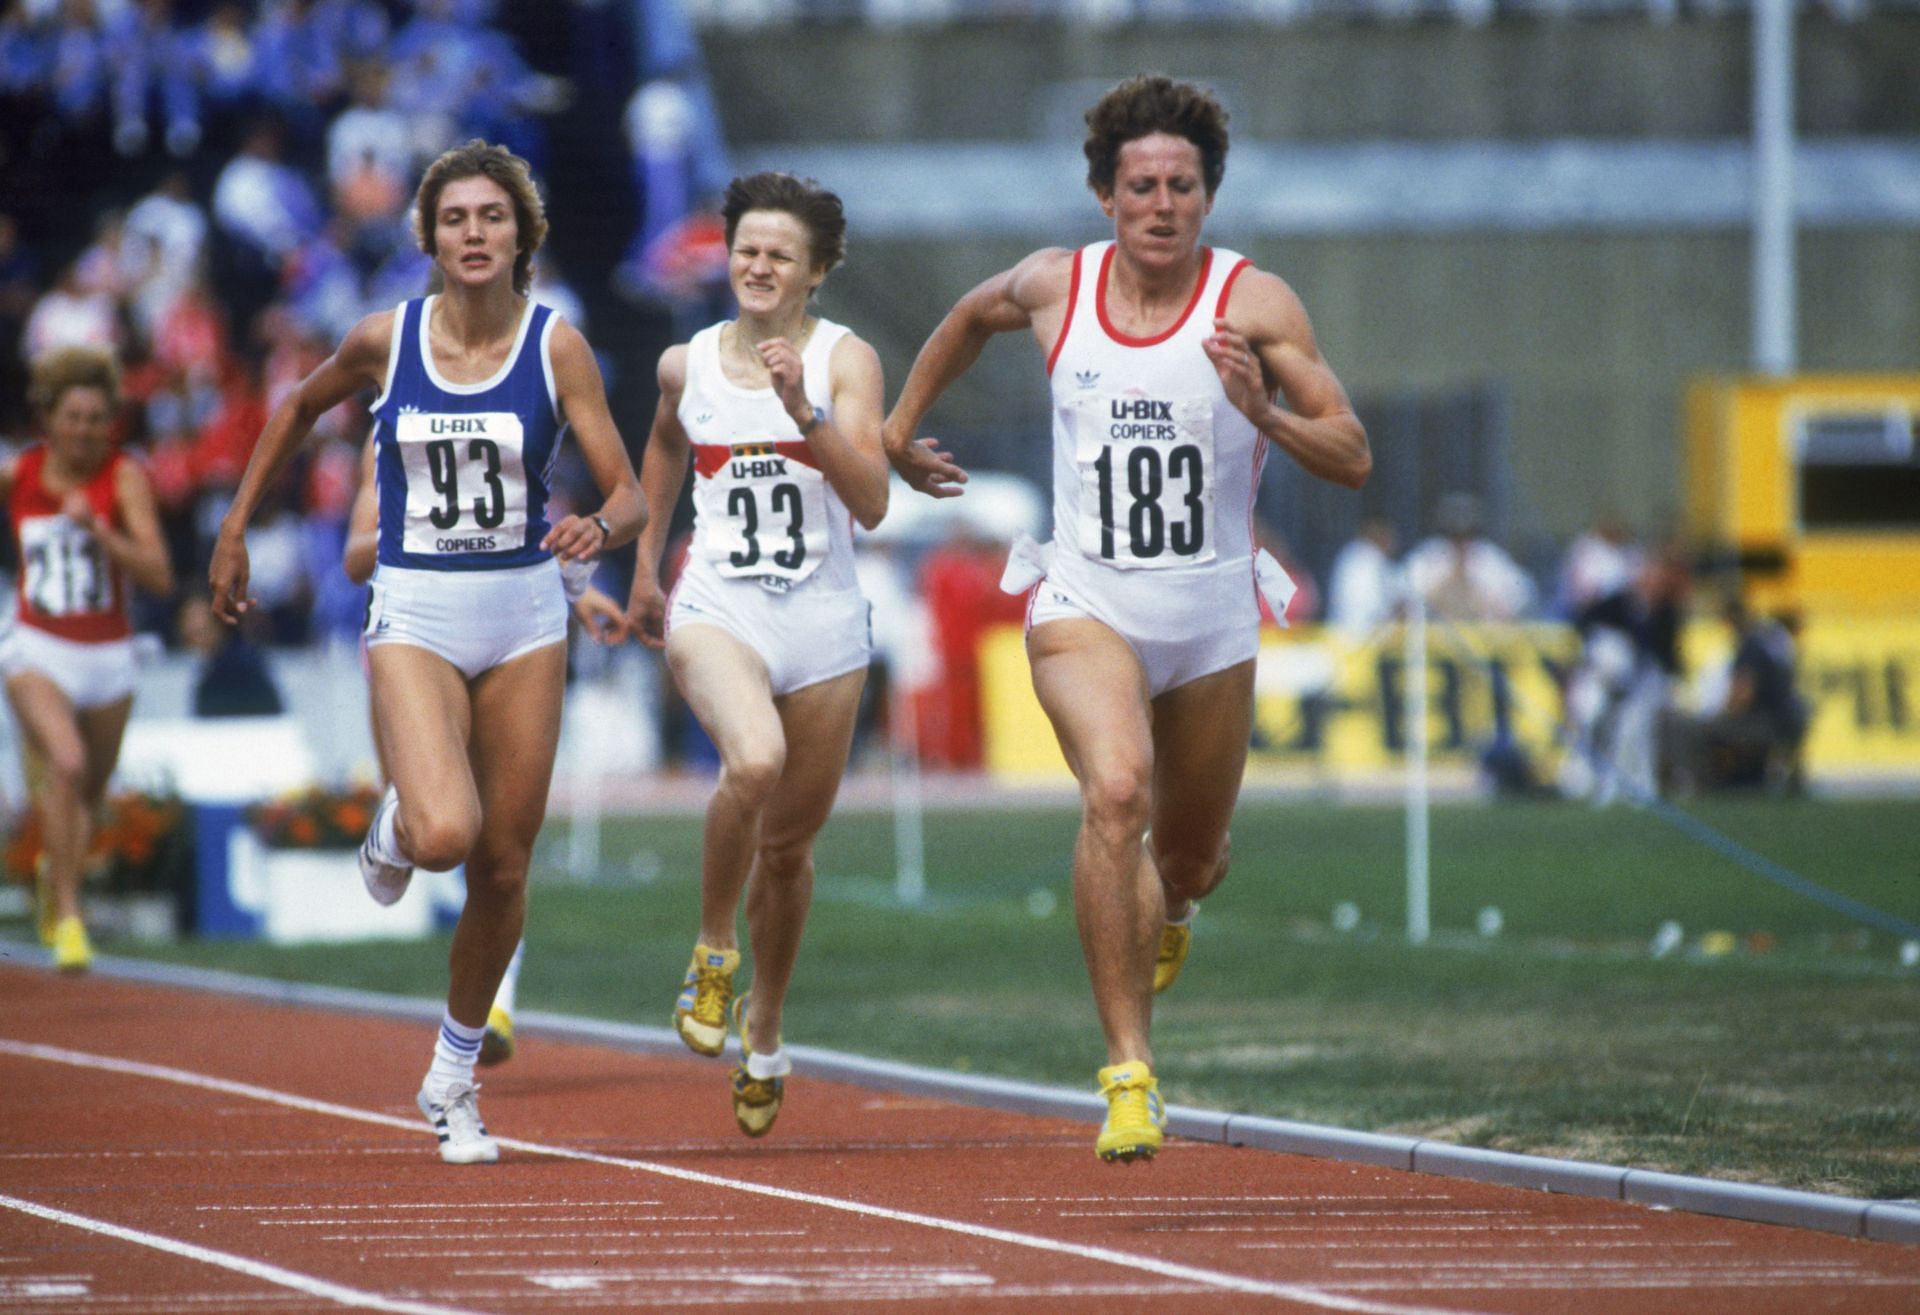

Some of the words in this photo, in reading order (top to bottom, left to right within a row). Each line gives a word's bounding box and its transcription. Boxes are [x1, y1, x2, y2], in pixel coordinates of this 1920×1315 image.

[1111, 399, 1173, 421] U-BIX
[430, 418, 488, 434] U-BIX
[1110, 424, 1176, 440] COPIERS
[732, 459, 787, 479] U-BIX
[426, 438, 505, 529] 93
[1094, 444, 1204, 560] 183
[728, 483, 807, 570] 33
[436, 536, 496, 552] COPIERS
